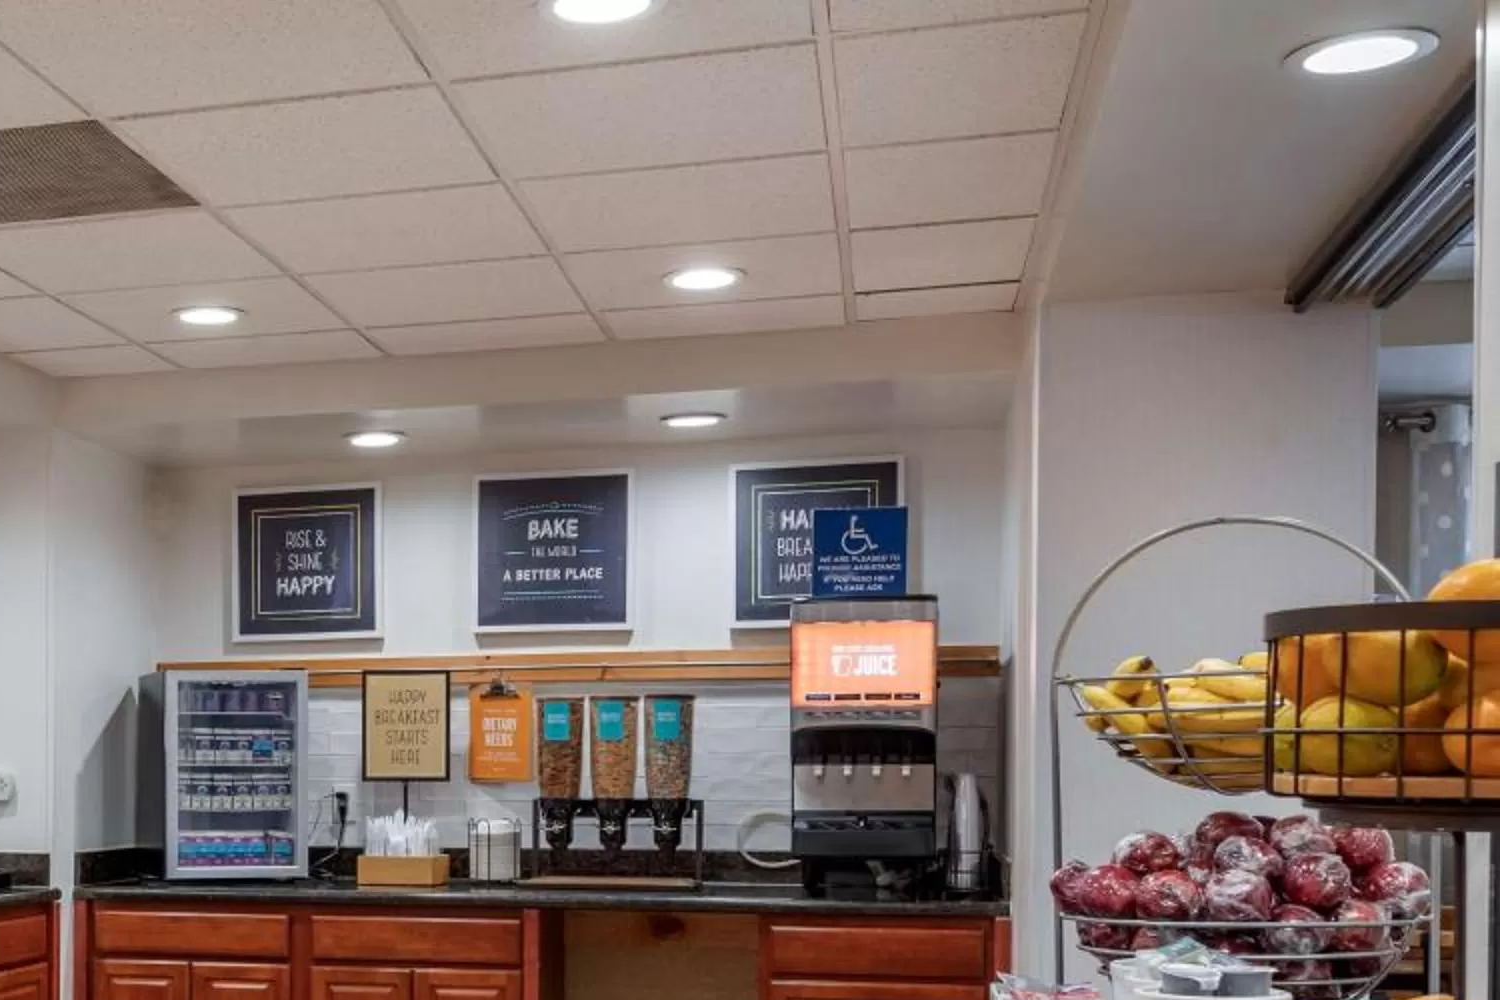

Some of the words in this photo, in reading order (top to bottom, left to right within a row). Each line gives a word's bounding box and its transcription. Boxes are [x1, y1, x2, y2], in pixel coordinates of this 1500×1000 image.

[527, 518, 579, 541] BAKE
[781, 509, 812, 531] HA
[285, 529, 312, 549] RISE
[315, 529, 327, 548] &
[287, 551, 323, 571] SHINE
[503, 569, 512, 582] A
[515, 568, 561, 581] BETTER
[564, 566, 604, 580] PLACE
[275, 575, 336, 597] HAPPY
[852, 654, 900, 677] JUICE
[375, 709, 441, 726] BREAKFAST
[385, 729, 429, 746] STARTS
[390, 748, 420, 765] HERE
